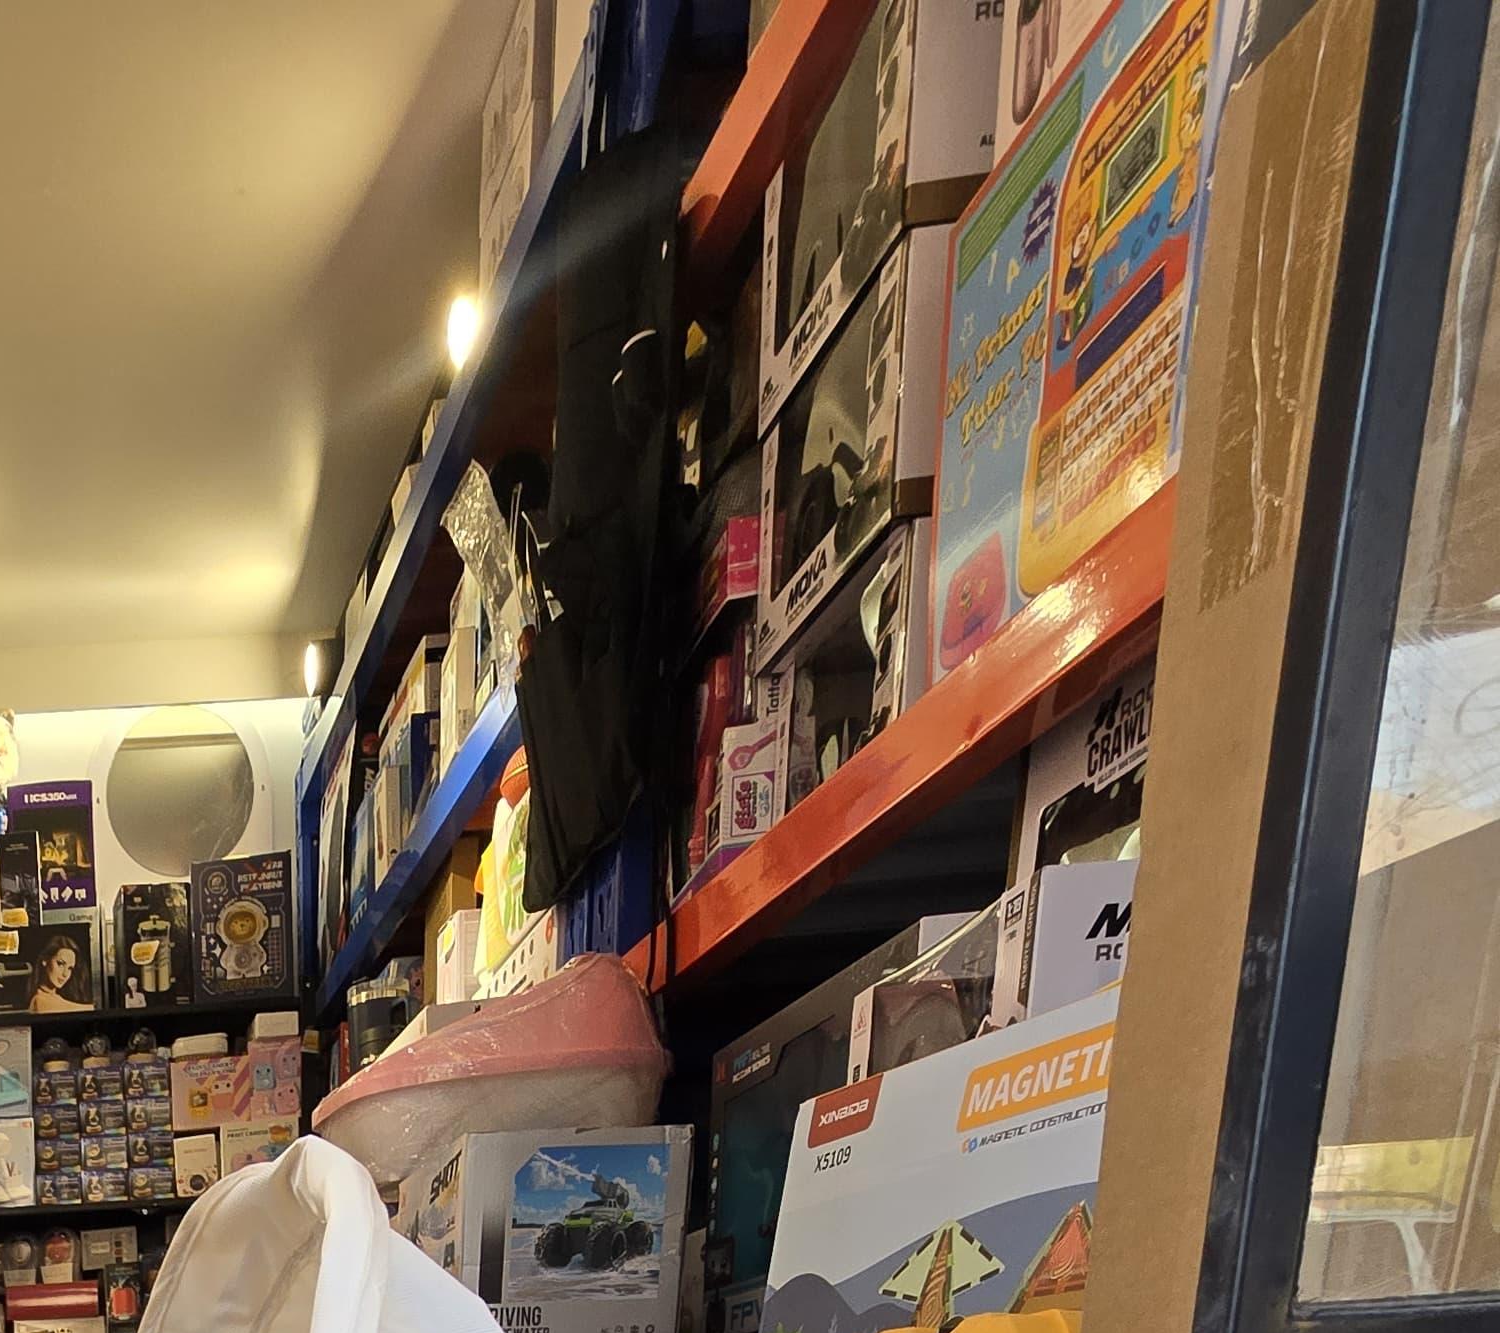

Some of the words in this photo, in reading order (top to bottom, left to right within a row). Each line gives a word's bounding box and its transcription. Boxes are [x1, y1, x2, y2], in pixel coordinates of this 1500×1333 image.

[965, 1037, 1115, 1119] MAGNETI
[979, 1123, 1028, 1147] MAGNETIC
[813, 1145, 852, 1175] X5109
